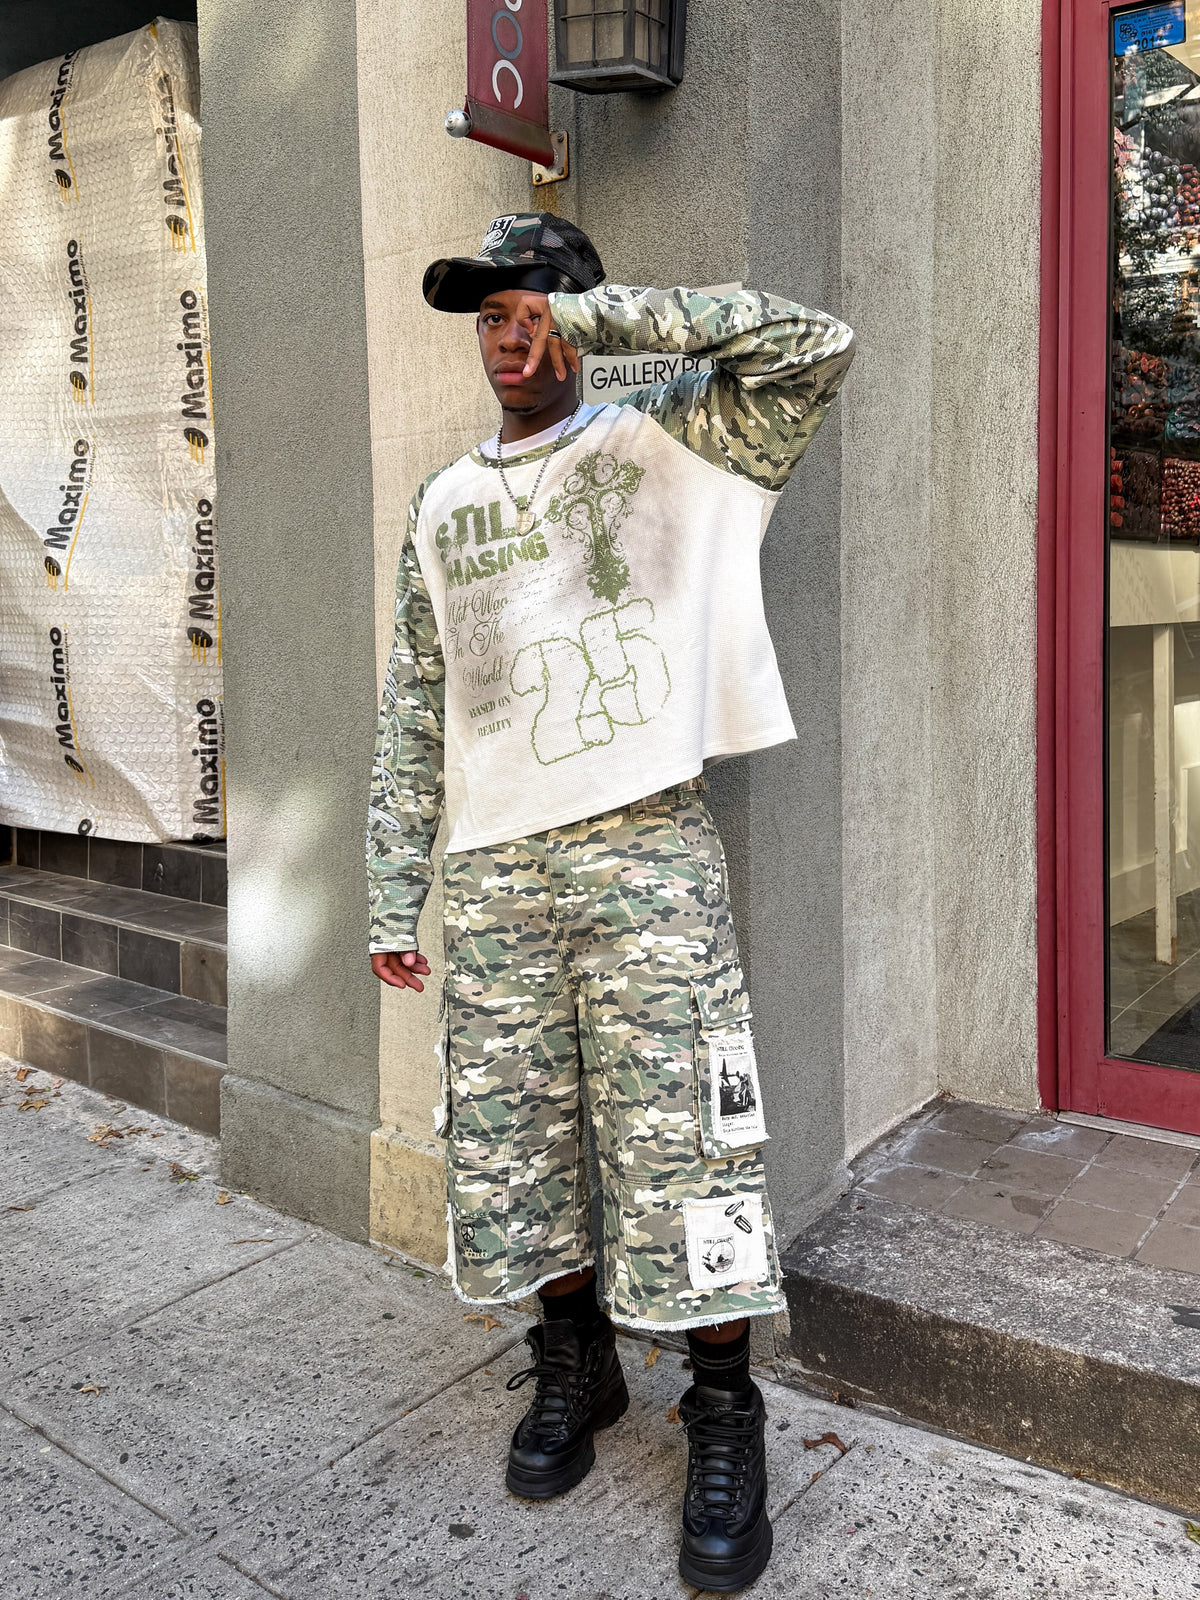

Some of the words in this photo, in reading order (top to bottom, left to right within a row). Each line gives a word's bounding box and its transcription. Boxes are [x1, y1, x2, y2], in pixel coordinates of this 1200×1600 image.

[492, 0, 523, 109] OC
[66, 239, 88, 363] Maximo
[177, 289, 206, 419] Maximo
[590, 358, 680, 390] GALLERY
[43, 438, 90, 550] Maximo
[188, 498, 215, 620] Maximo
[441, 531, 549, 590] HASING
[50, 627, 76, 749] Maximo
[468, 700, 496, 718] BASED
[498, 694, 511, 708] ON
[477, 717, 512, 737] REALITY
[192, 698, 219, 824] Maximo
